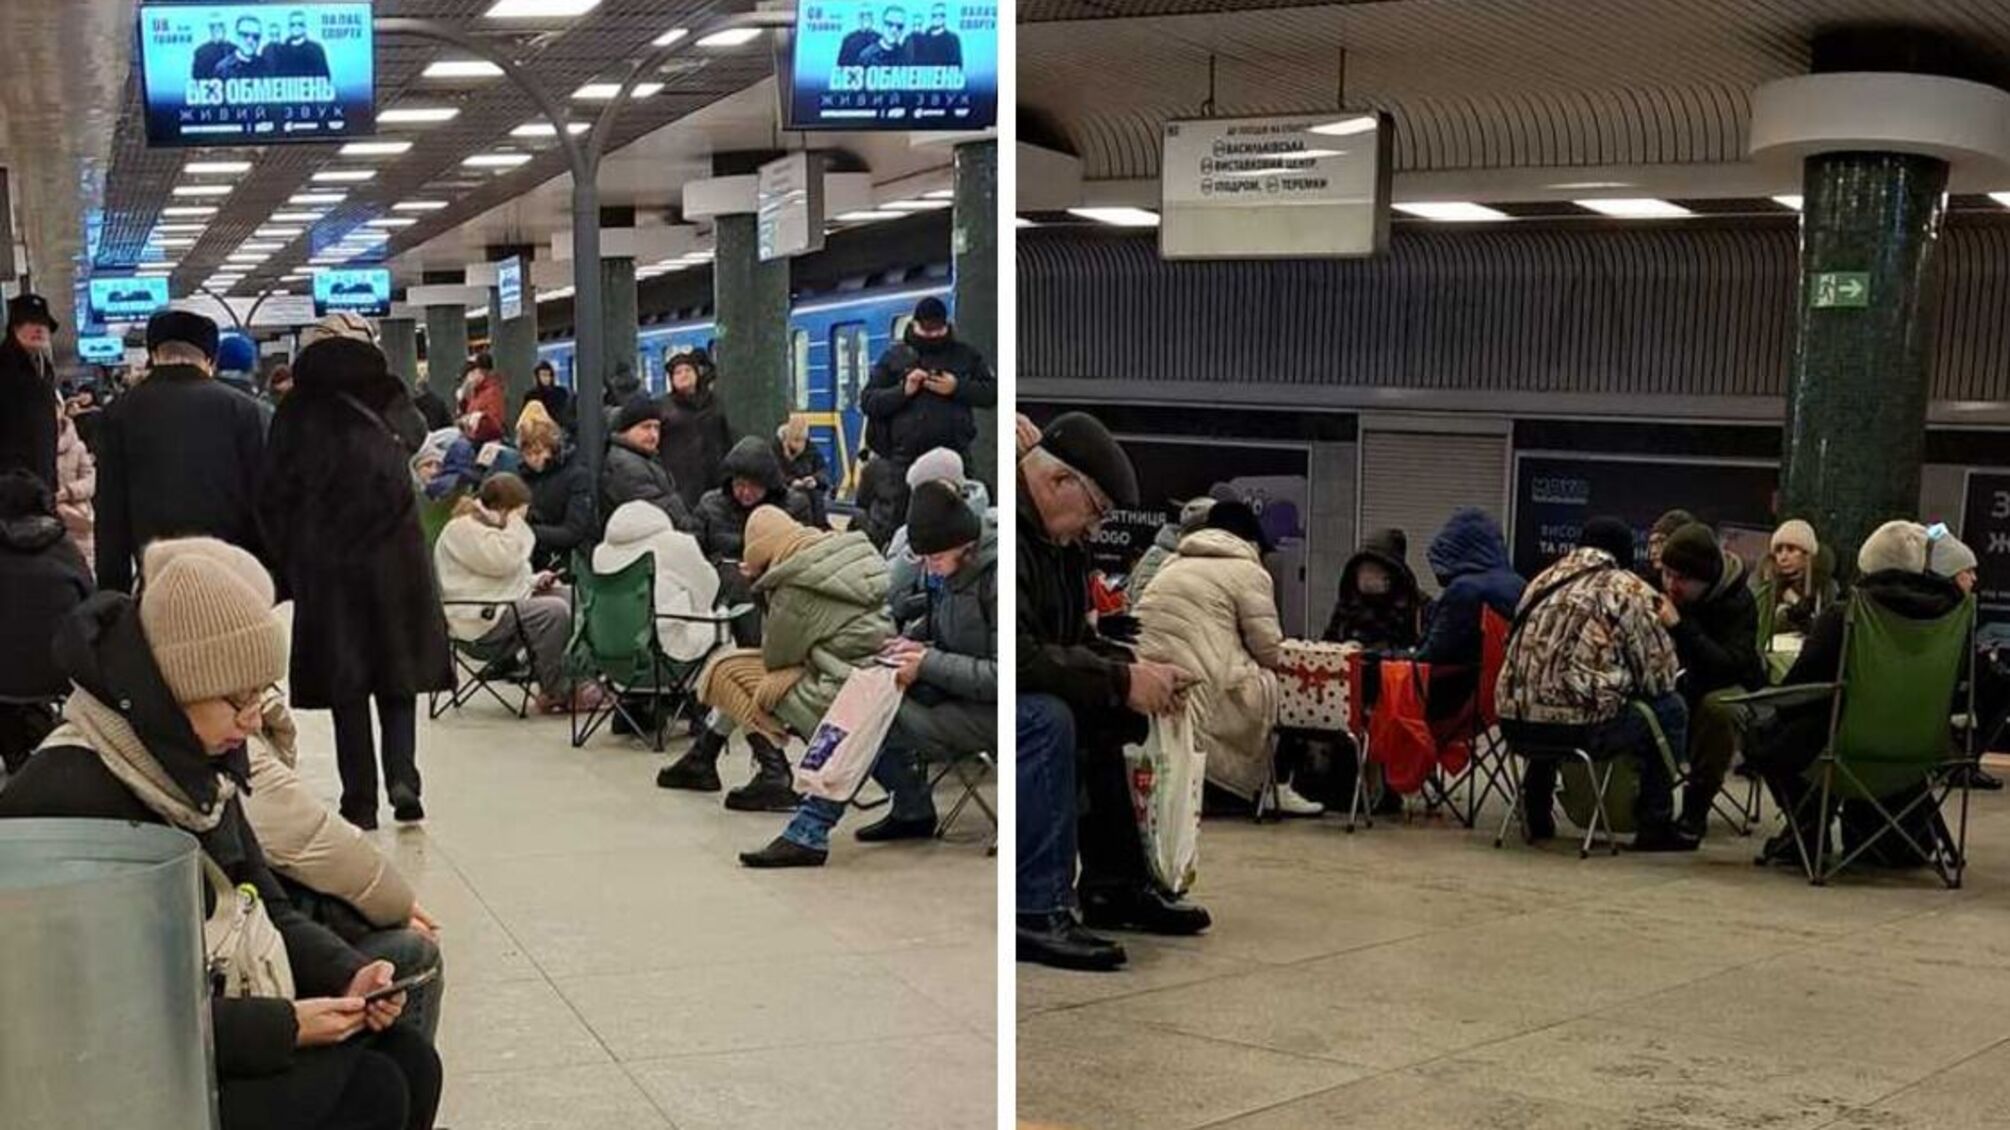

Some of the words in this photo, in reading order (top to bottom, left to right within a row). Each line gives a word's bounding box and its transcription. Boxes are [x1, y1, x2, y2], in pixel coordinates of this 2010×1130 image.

[829, 65, 865, 91] БЕЗ
[185, 77, 224, 106] БЕЗ
[821, 93, 900, 107] ЖИВИЙ
[916, 93, 970, 106] ЗВУК
[179, 105, 267, 121] ЖИВИЙ
[284, 106, 344, 119] ЗВУК
